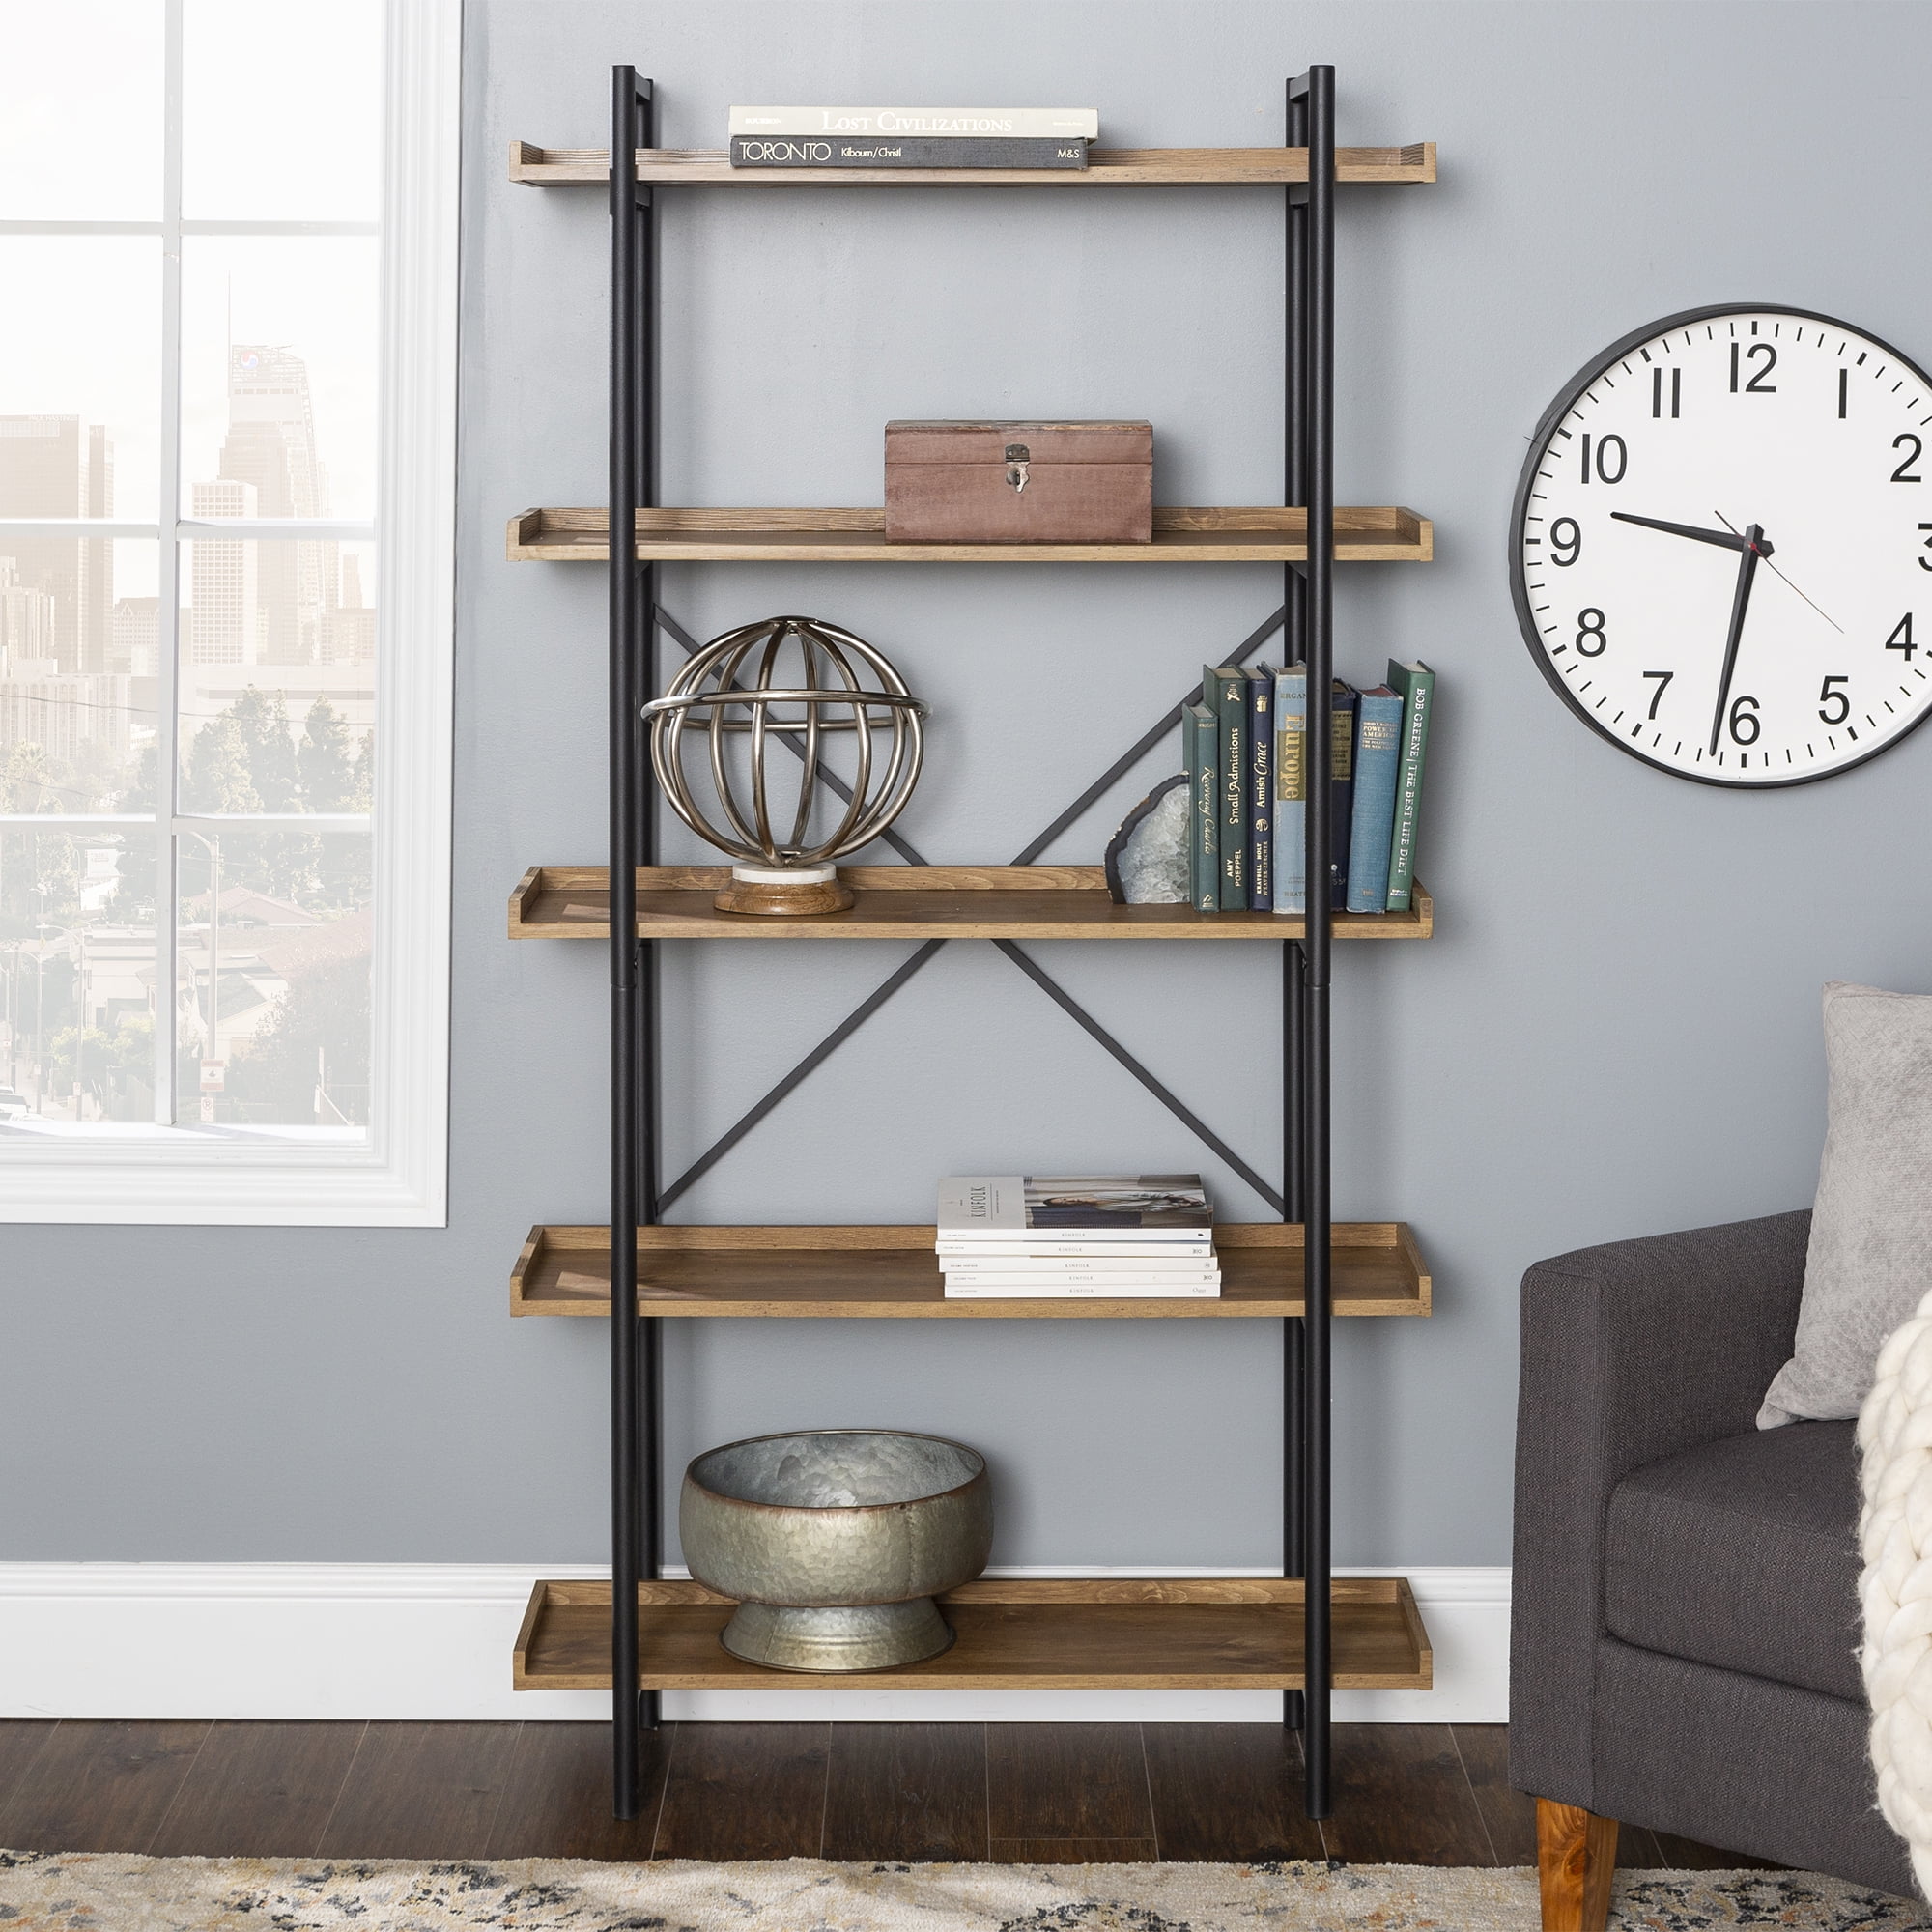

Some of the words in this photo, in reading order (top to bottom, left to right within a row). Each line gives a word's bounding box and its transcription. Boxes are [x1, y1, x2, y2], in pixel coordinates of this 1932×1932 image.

[822, 111, 872, 130] LOST
[877, 111, 1013, 132] CIVILIZATIONS
[739, 142, 832, 161] TORONTO
[1057, 148, 1080, 159] M&S
[1730, 343, 1776, 392] 12
[1653, 368, 1680, 418] 11
[1839, 369, 1848, 418] 1
[1582, 434, 1628, 484] 10
[1890, 434, 1921, 482] 2
[1550, 518, 1581, 566] 9
[1576, 608, 1606, 657] 8
[1886, 612, 1918, 661] 4
[1415, 688, 1426, 710] BOB
[1643, 671, 1674, 720] 7
[1819, 676, 1850, 724] 5
[1410, 713, 1423, 757] GREENE
[1730, 696, 1761, 745] 6
[1228, 727, 1241, 792] Admissions
[1254, 741, 1269, 776] Grace
[1280, 714, 1304, 799] Europe
[1406, 765, 1417, 787] THE
[1228, 793, 1239, 825] Small
[1256, 776, 1265, 808] Amish
[1404, 790, 1415, 818] BEST
[1401, 821, 1411, 845] LIFE
[1398, 848, 1408, 876] DIET
[970, 1186, 986, 1217] KINFOLK
